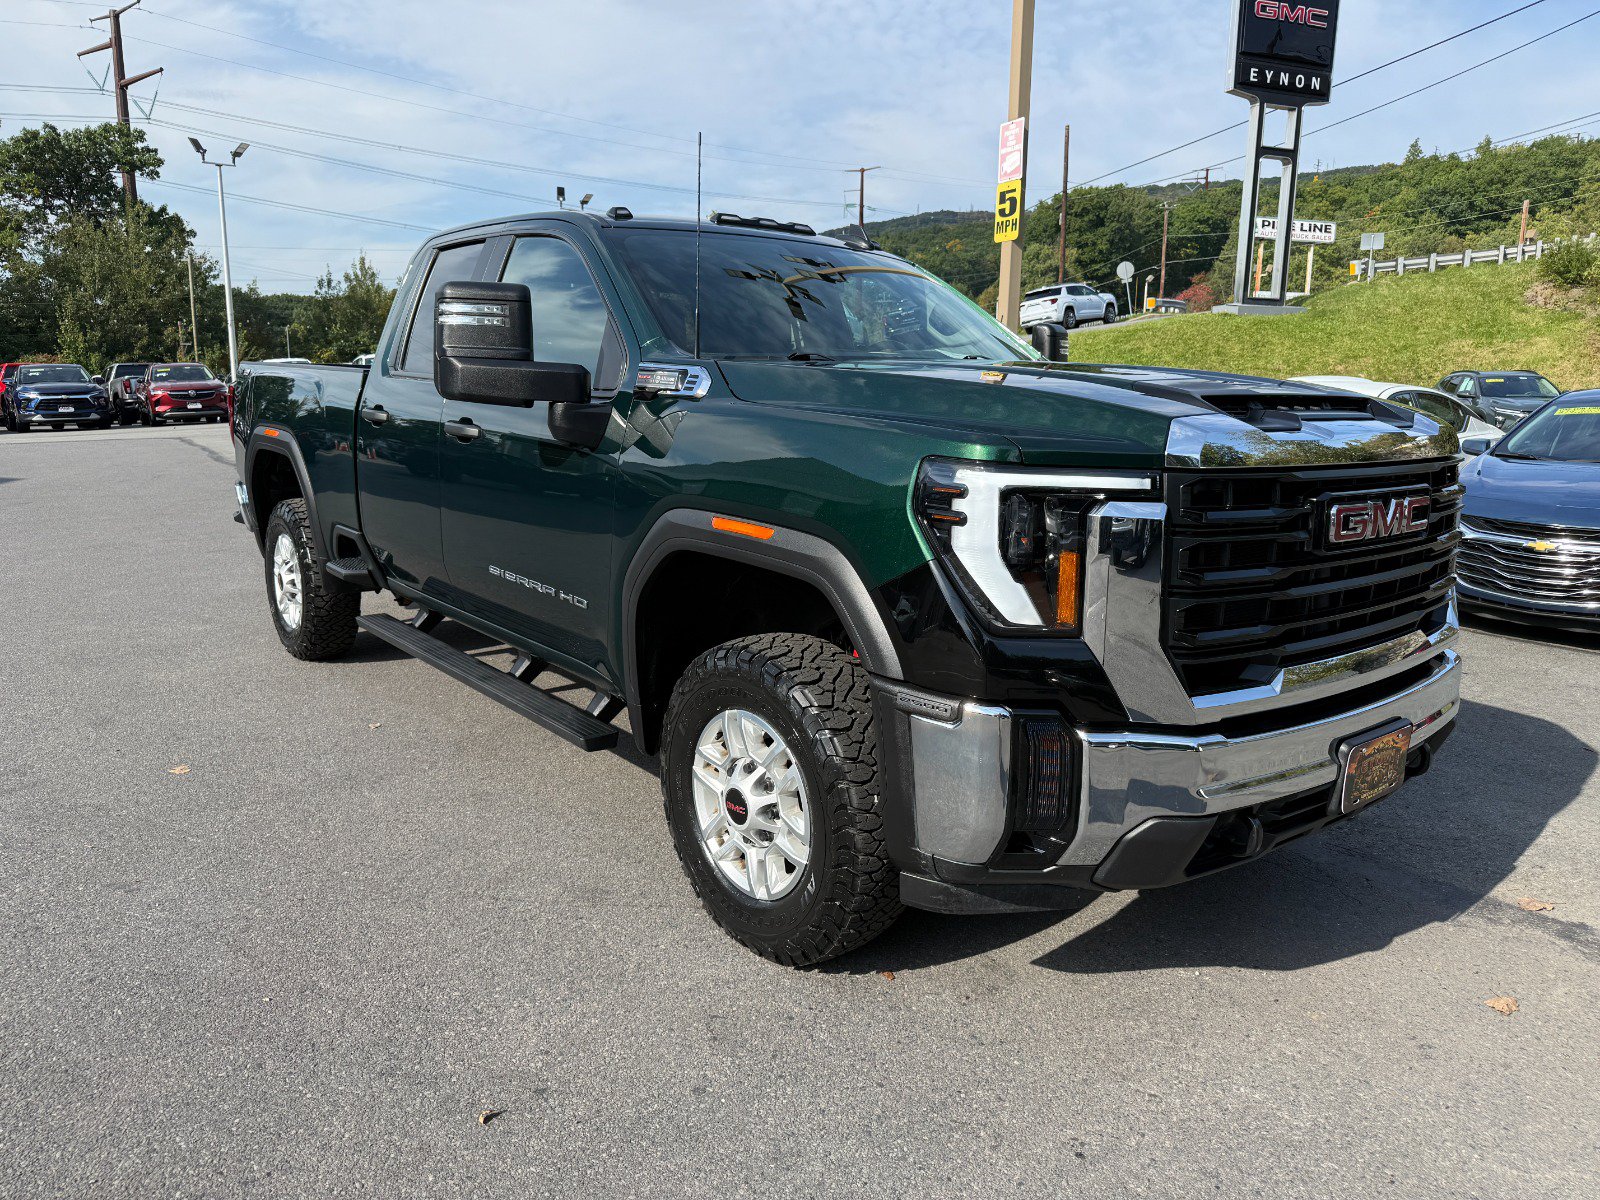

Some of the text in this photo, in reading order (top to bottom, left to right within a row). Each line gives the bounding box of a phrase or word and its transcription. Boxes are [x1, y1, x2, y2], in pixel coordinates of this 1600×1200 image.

[1255, 0, 1328, 28] GMC
[1250, 68, 1320, 90] EYNON
[998, 188, 1018, 218] 5
[996, 218, 1018, 234] MPH
[1300, 222, 1332, 233] LINE
[1329, 496, 1430, 543] GMC
[489, 565, 588, 609] SIERRA HD
[898, 696, 949, 713] 2500
[725, 801, 746, 815] GMC
